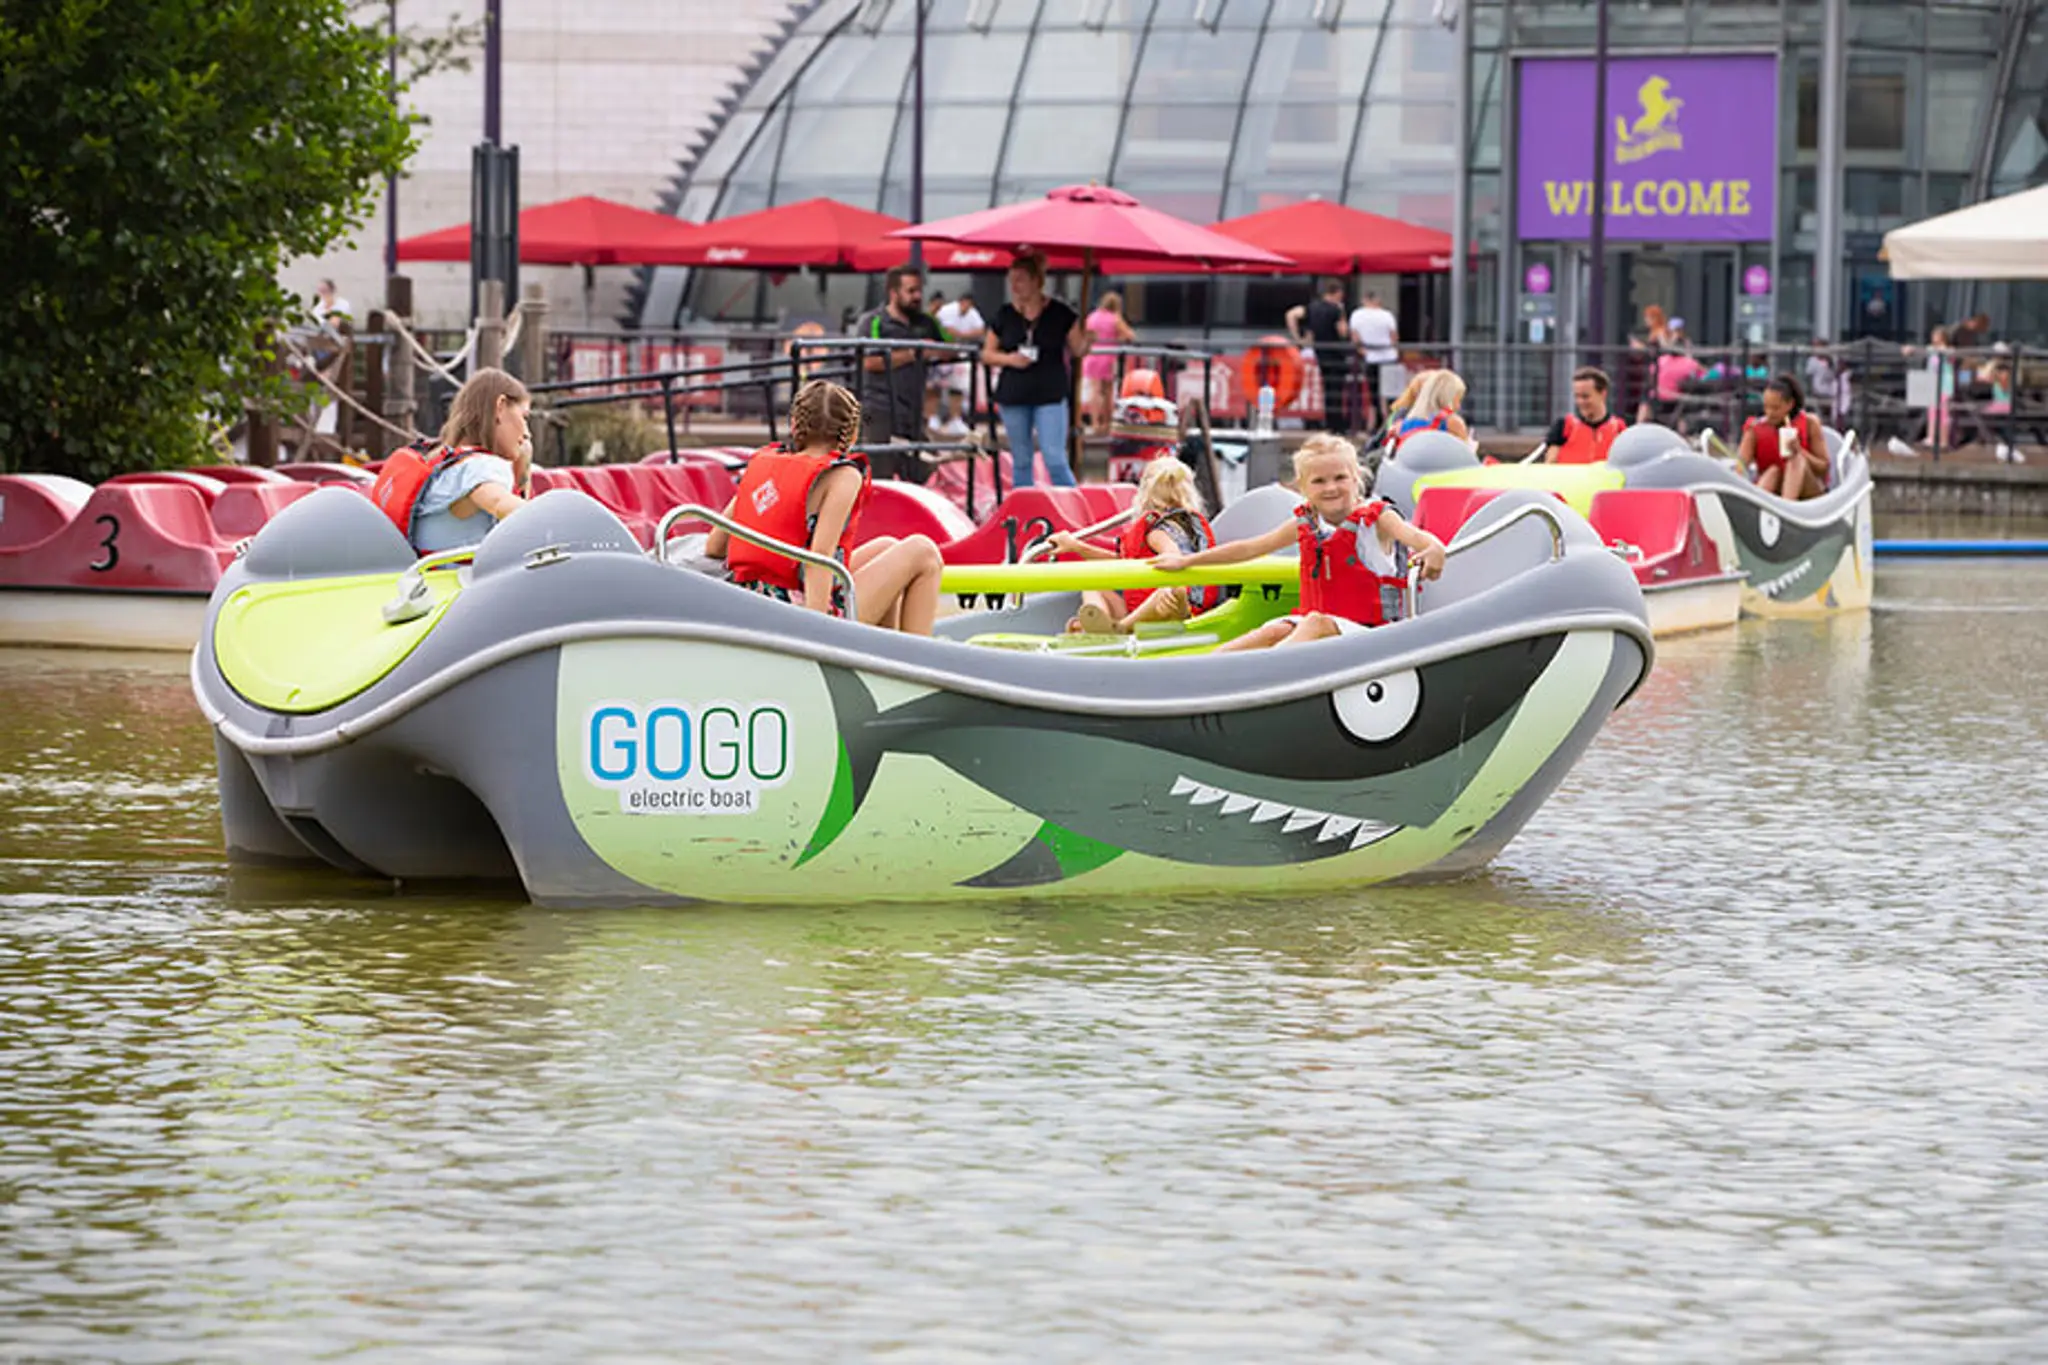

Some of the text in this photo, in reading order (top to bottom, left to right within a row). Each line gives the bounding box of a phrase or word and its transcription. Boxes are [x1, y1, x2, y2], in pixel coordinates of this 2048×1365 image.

[89, 513, 119, 572] 3
[1001, 516, 1057, 564] 12
[590, 707, 787, 781] GOGO
[629, 788, 752, 808] electric boat
